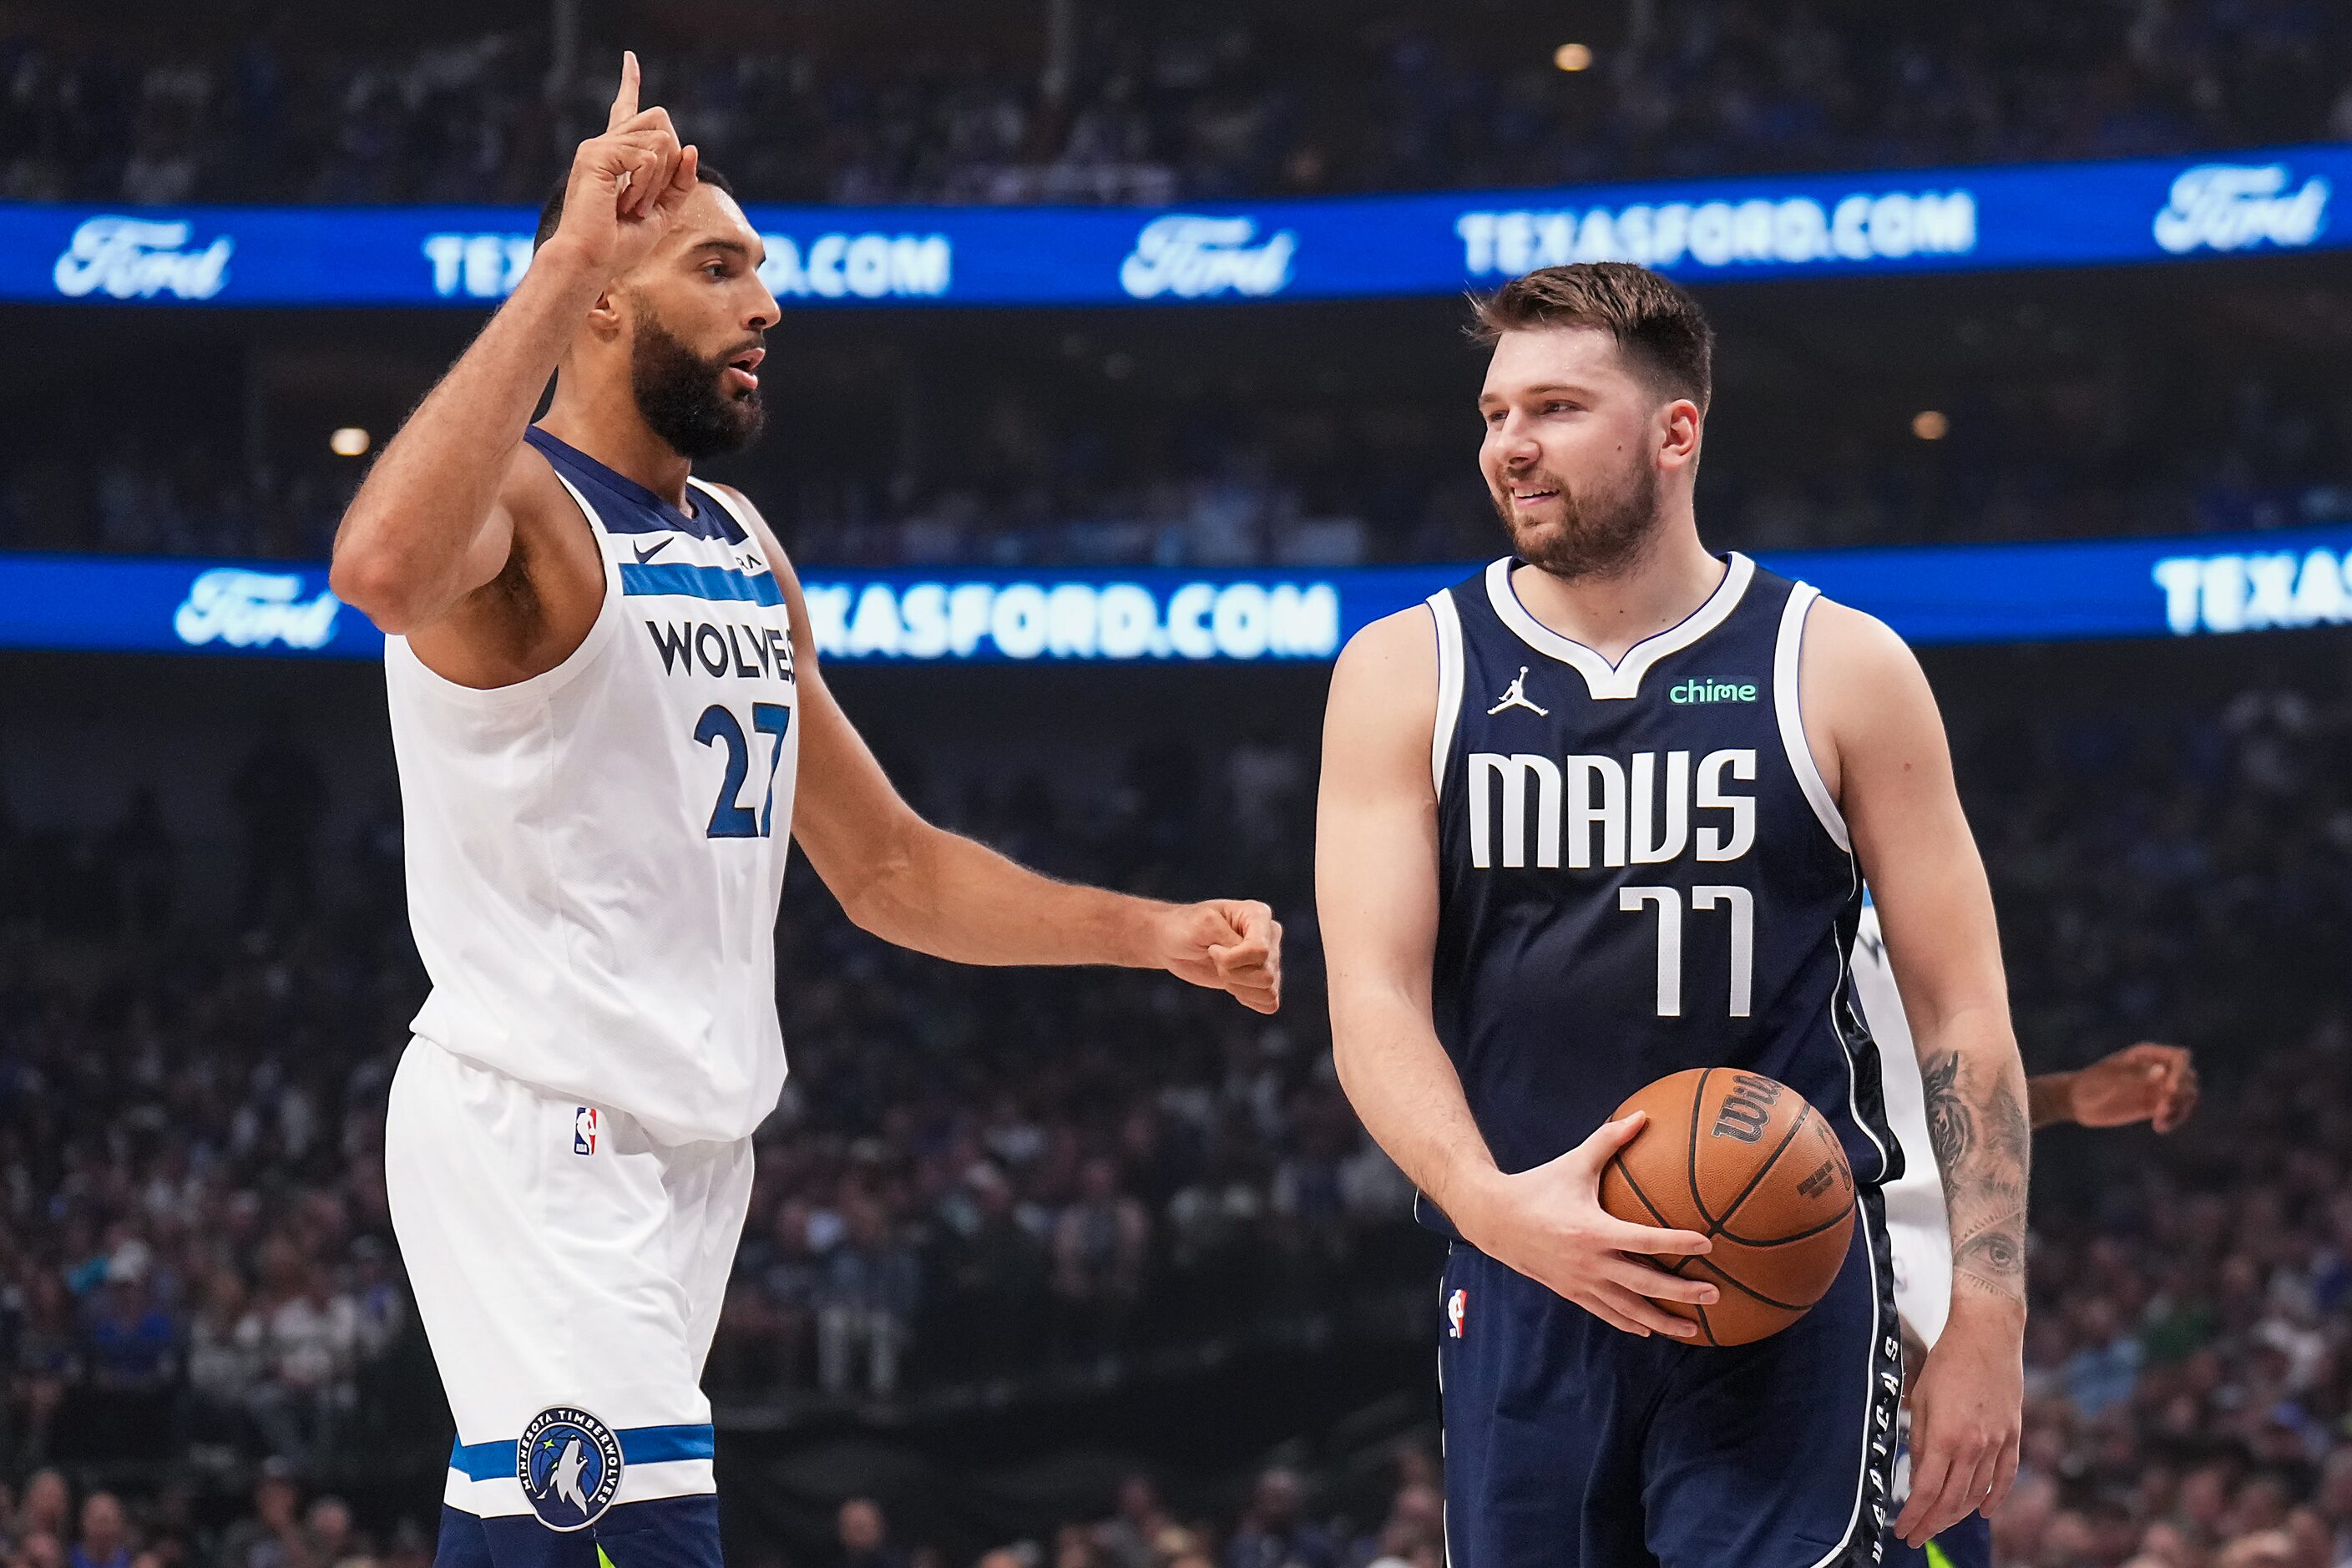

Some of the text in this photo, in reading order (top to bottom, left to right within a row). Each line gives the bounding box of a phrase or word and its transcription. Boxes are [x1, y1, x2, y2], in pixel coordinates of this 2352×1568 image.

[1457, 190, 1975, 276] TEXASFORD.COM
[2152, 164, 2329, 253] Ford
[53, 215, 232, 300] Ford
[1120, 214, 1297, 299] Ford
[175, 568, 340, 650] Ford
[1669, 678, 1756, 703] chime
[693, 702, 790, 838] 27
[1468, 749, 1756, 868] MAVS
[1619, 885, 1753, 1017] 77
[520, 1410, 618, 1504] MINNESOTA TIMBERWOLVES
